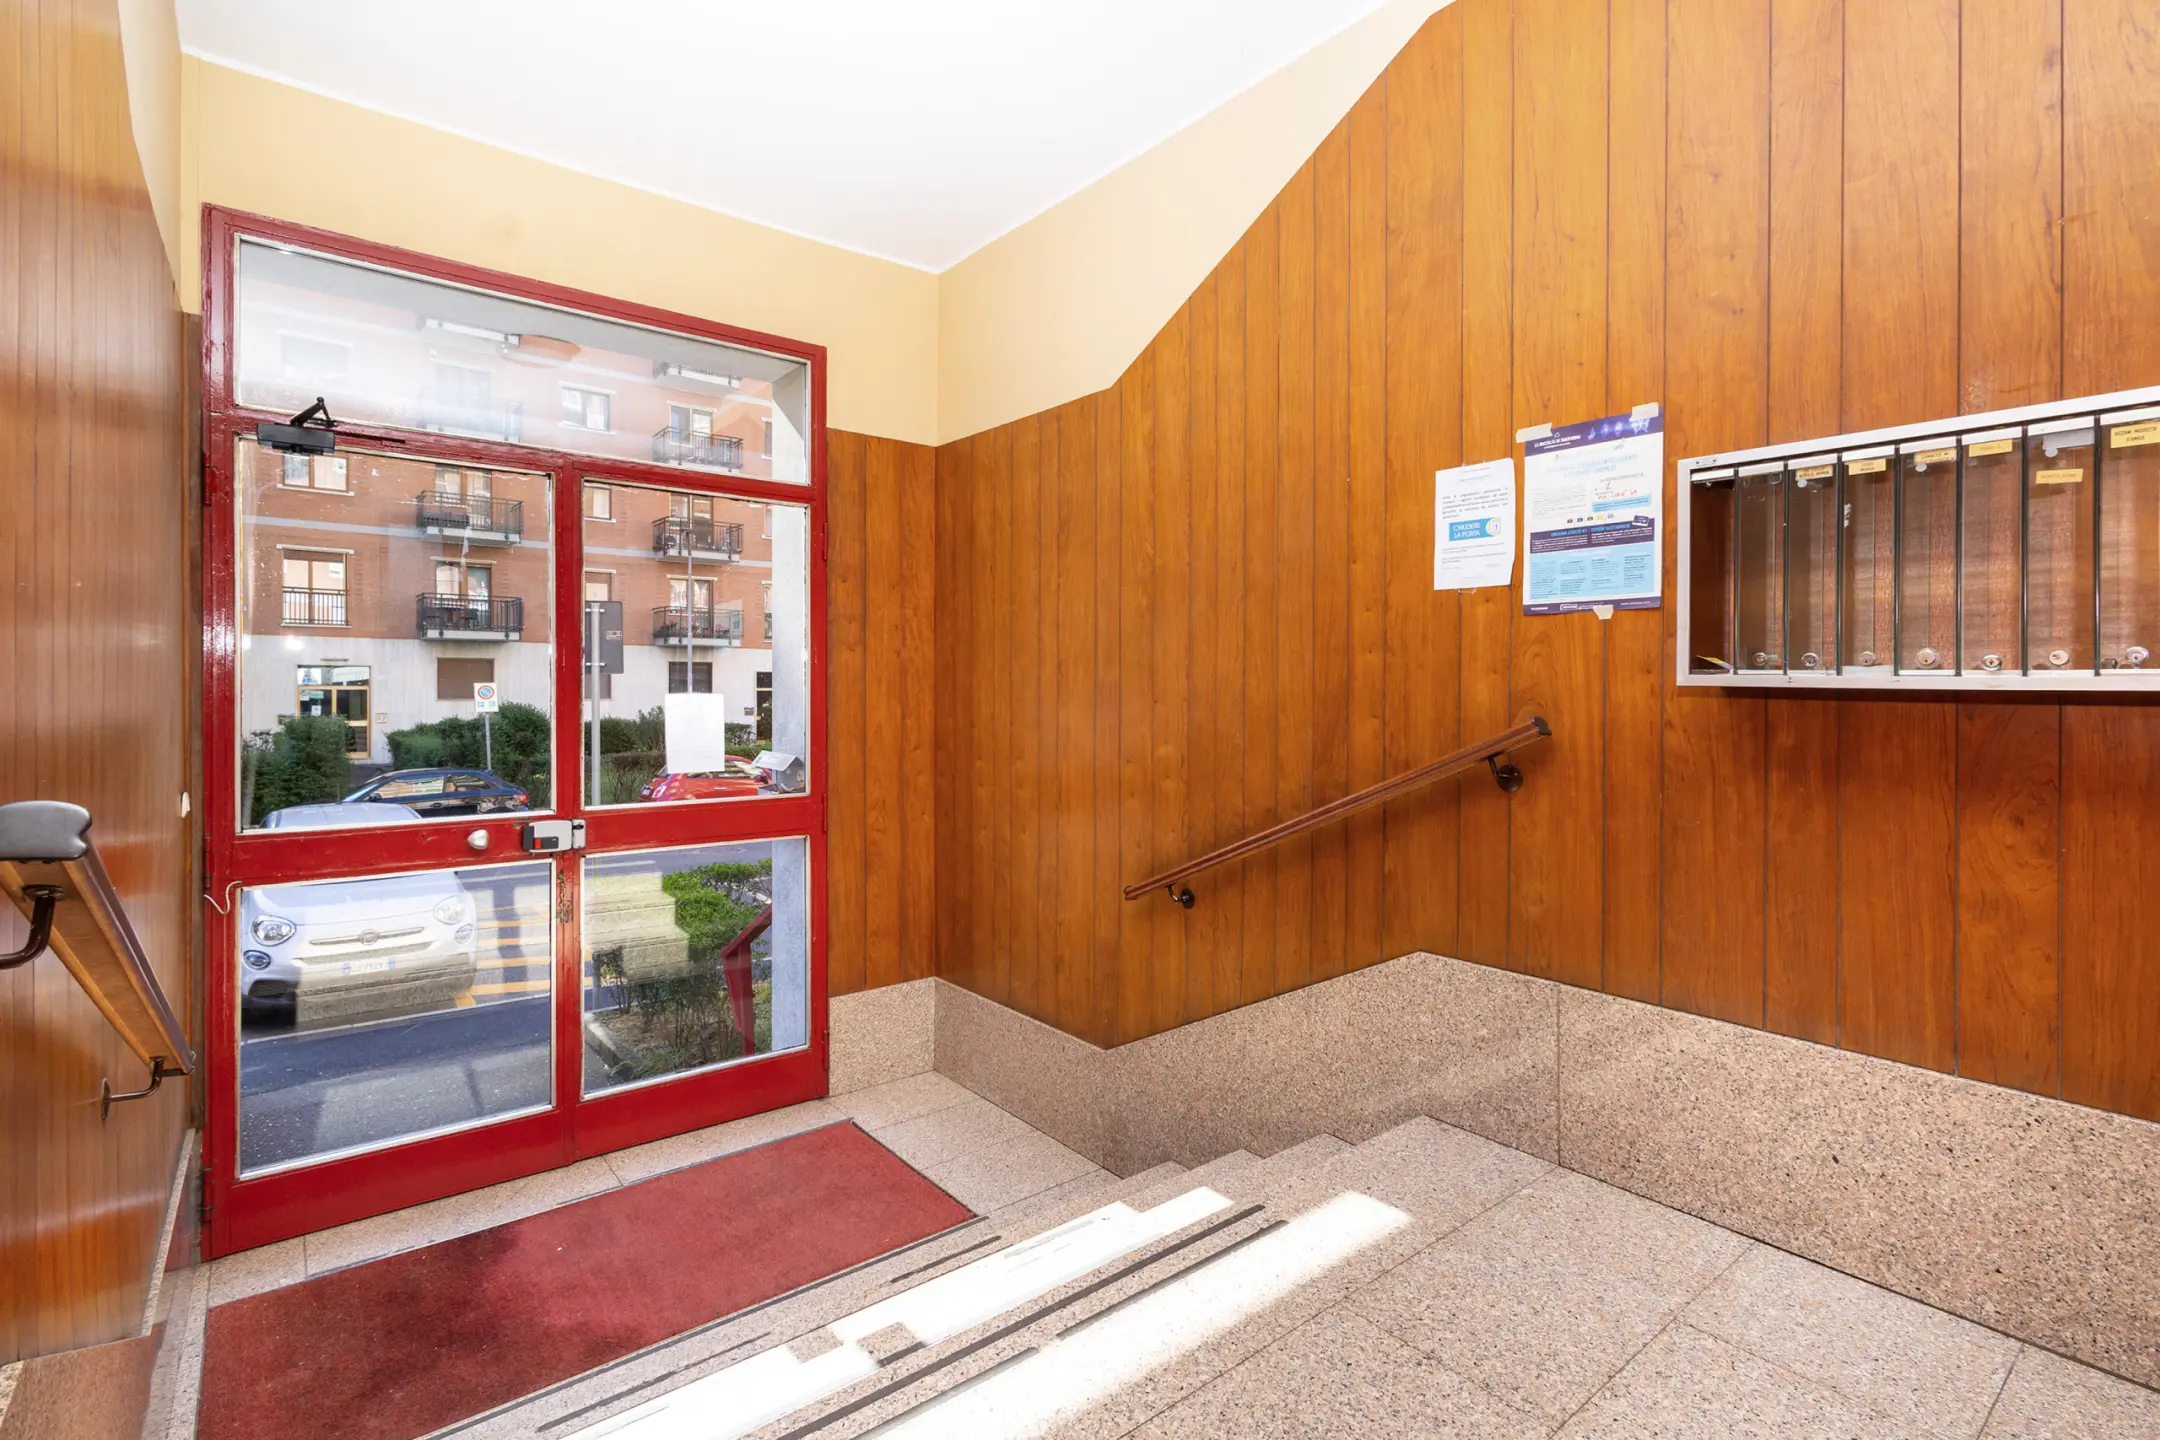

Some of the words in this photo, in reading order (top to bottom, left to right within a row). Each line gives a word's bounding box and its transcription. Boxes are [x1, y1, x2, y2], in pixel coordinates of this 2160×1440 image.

[1453, 522, 1480, 532] CHIUDERE
[1453, 531, 1461, 539] LA
[1461, 530, 1480, 538] PORTA
